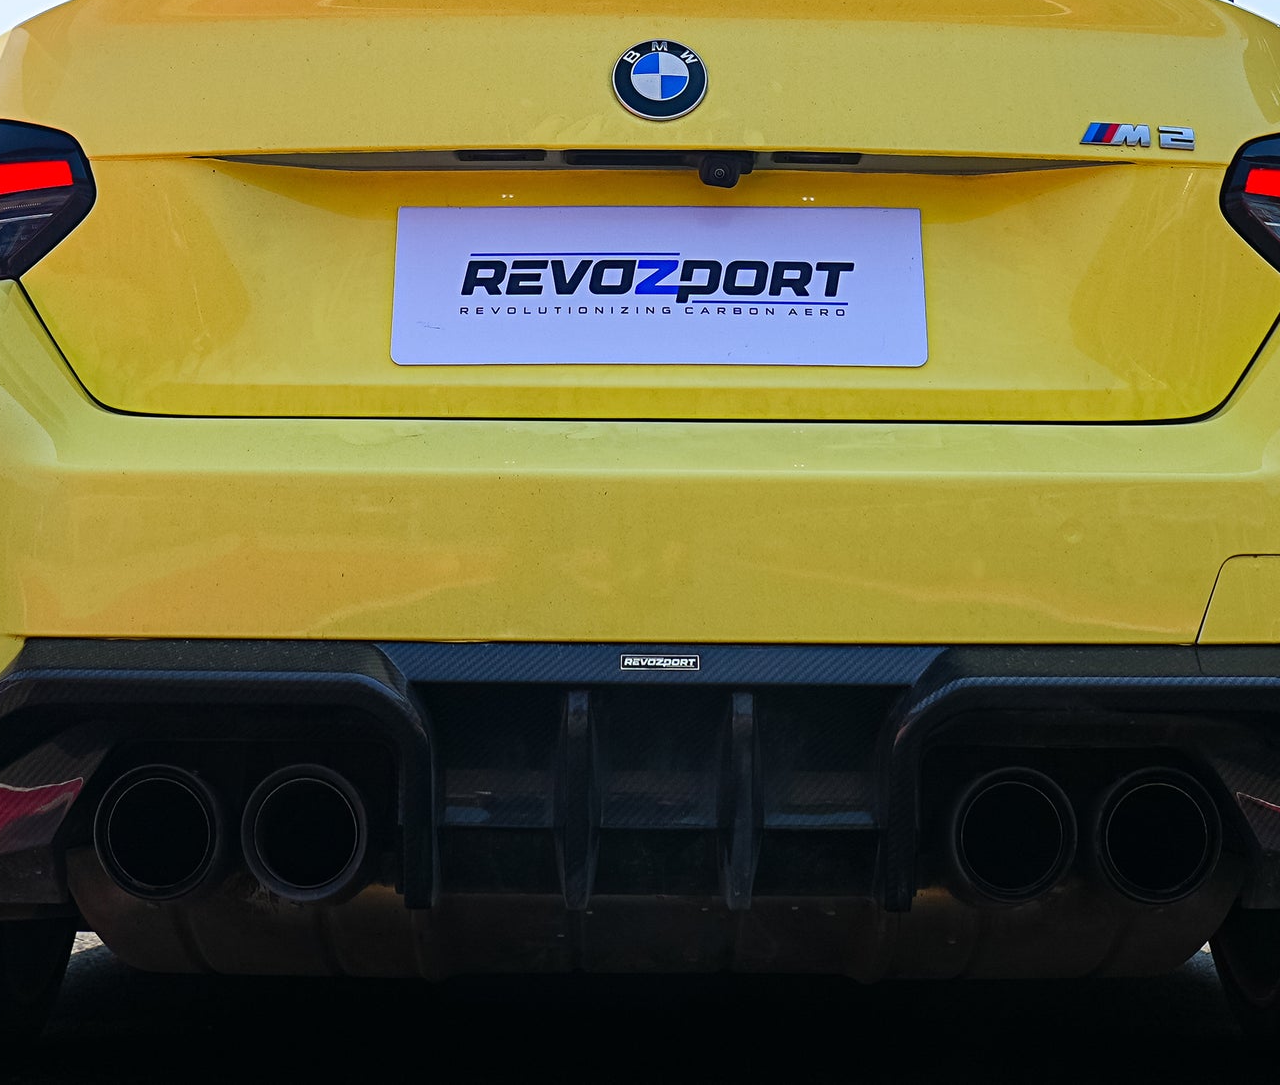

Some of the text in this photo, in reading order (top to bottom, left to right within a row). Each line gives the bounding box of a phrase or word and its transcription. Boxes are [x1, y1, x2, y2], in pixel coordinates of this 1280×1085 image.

[622, 41, 698, 64] BMW
[460, 260, 855, 304] REVOZPORT
[459, 306, 846, 317] REVOLUTIONIZING CARBON AERO
[623, 657, 697, 668] REVOZPORT
